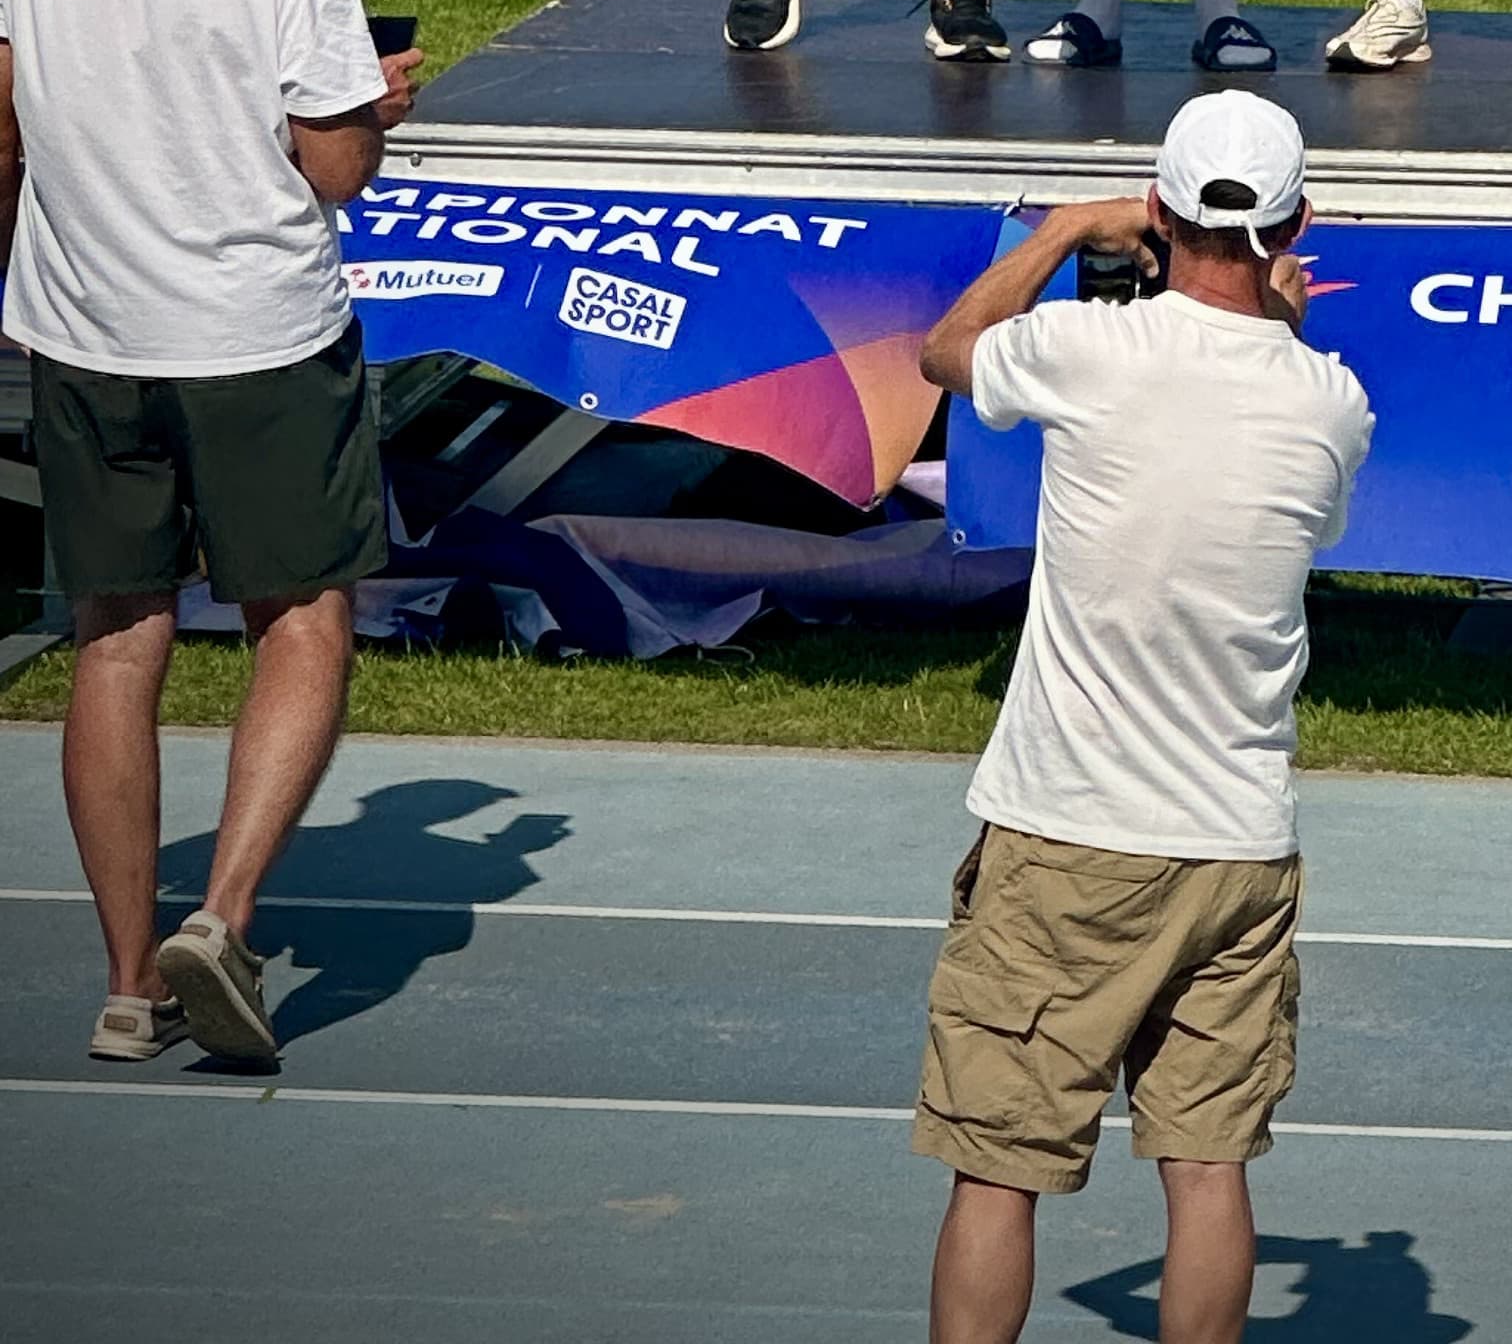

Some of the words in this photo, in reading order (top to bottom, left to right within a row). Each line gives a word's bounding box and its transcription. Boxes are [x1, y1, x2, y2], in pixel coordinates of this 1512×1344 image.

[361, 186, 868, 248] MPIONNAT
[336, 208, 720, 277] TIONAL
[375, 268, 486, 290] Mutuel
[576, 274, 674, 319] CASAL
[568, 298, 671, 341] SPORT
